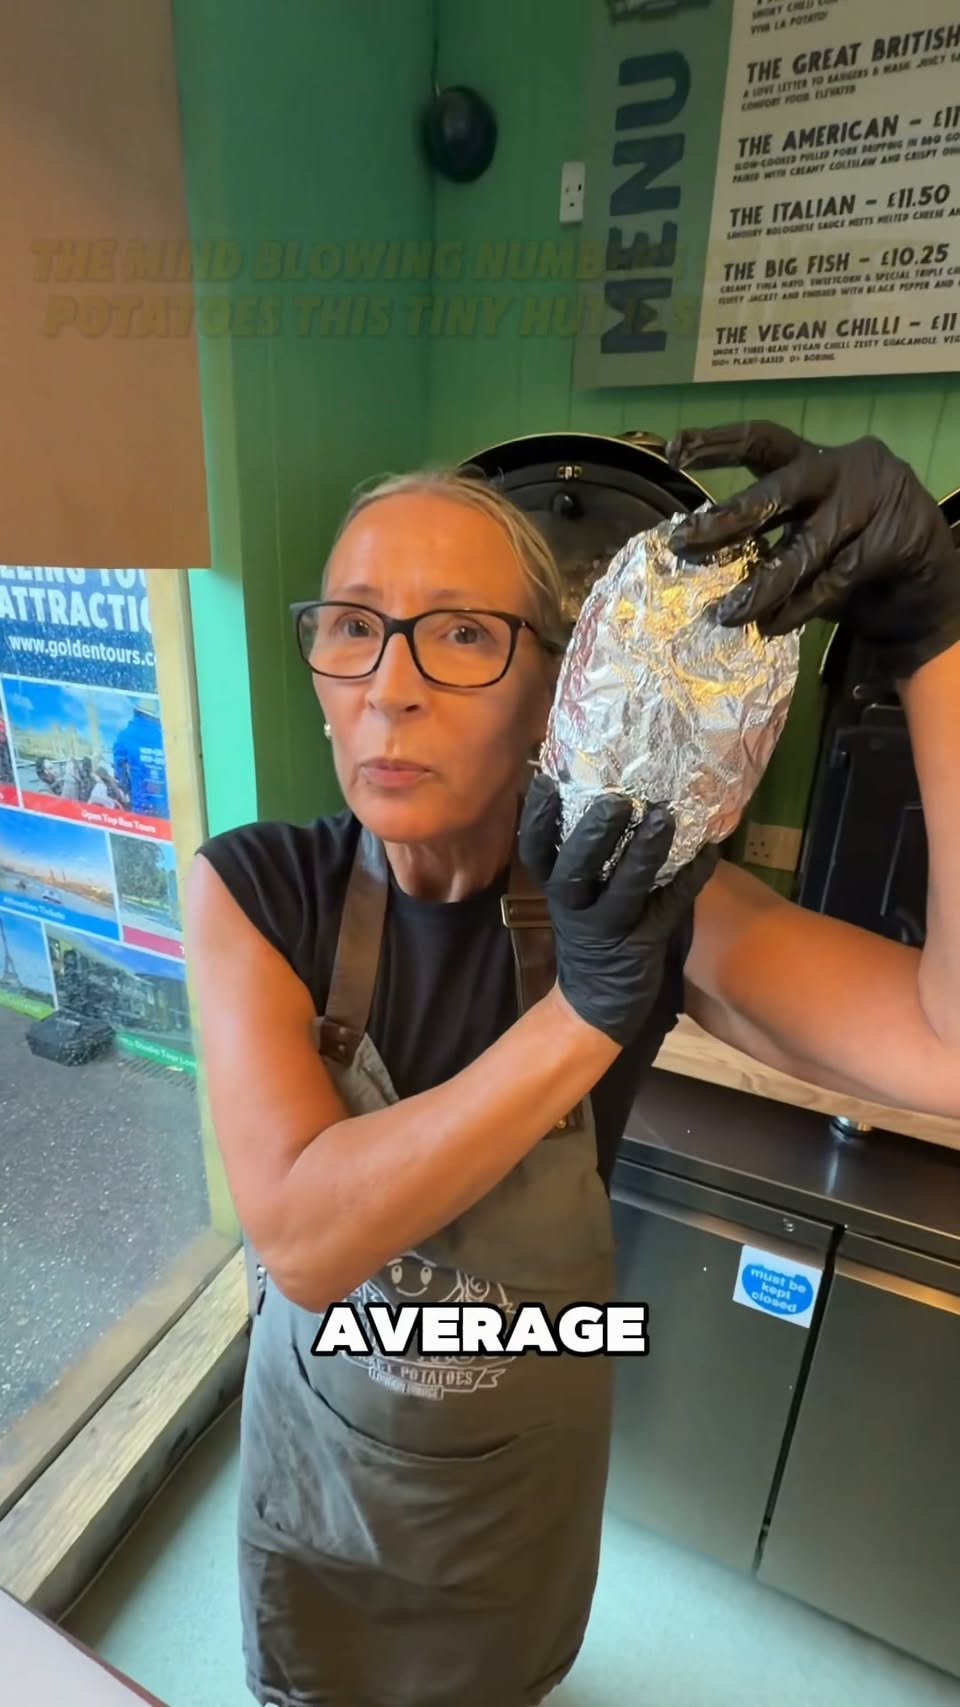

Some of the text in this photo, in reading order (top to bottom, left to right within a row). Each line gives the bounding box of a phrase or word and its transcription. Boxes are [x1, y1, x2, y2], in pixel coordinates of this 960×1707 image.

[774, 20, 786, 30] LA
[747, 24, 960, 85] THE GREAT BRITISH
[752, 85, 774, 97] LOVE
[777, 79, 808, 93] LETTER
[812, 76, 825, 87] TO
[828, 69, 869, 84] BANGERS
[872, 66, 880, 77] &
[741, 97, 781, 112] COMFORT
[738, 134, 773, 158] THE
[782, 114, 900, 152] AMERICAN
[800, 150, 830, 162] PULLED
[833, 146, 857, 158] PORK
[907, 138, 918, 147] IN
[732, 172, 760, 184] PAIRED
[764, 169, 786, 180] WITH
[790, 164, 825, 176] CREAMY
[829, 158, 877, 171] COLESLAW
[881, 153, 901, 164] AND
[904, 149, 938, 162] CRISPY
[600, 50, 691, 355] MENU
[730, 205, 763, 228] THE
[772, 194, 856, 223] ITALIAN
[887, 184, 950, 209] £11.50
[766, 222, 814, 236] BOLOGNESE
[817, 219, 845, 230] SAUCE
[848, 216, 874, 228] MEETS
[878, 212, 909, 224] MELTED
[912, 207, 944, 220] CHEESE
[723, 261, 756, 282] THE
[765, 257, 798, 279] BIG
[806, 251, 850, 275] FISH
[880, 243, 950, 267] £10.25
[720, 283, 752, 294] CREAMY
[756, 281, 777, 291] TUNA
[875, 270, 910, 281] SPECIAL
[915, 267, 944, 278] TRIPLE
[748, 292, 778, 303] JACKET
[782, 290, 799, 300] AND
[802, 288, 836, 299] FINISHED
[840, 286, 864, 297] WITH
[867, 284, 895, 295] BLACK
[899, 281, 930, 292] PEPPER
[934, 279, 954, 289] AND
[716, 325, 748, 345] THE
[758, 319, 827, 342] VEGAN
[836, 315, 900, 338] CHILLI
[931, 312, 958, 332] £11
[792, 342, 821, 352] VEGAN
[854, 339, 879, 349] ZESTY
[804, 353, 835, 363] BORING
[8, 635, 157, 667] www.goldentours.c
[750, 1267, 807, 1294] must be
[761, 1281, 791, 1301] kept
[751, 1290, 798, 1313] closed
[400, 1368, 474, 1386] POTATOES
